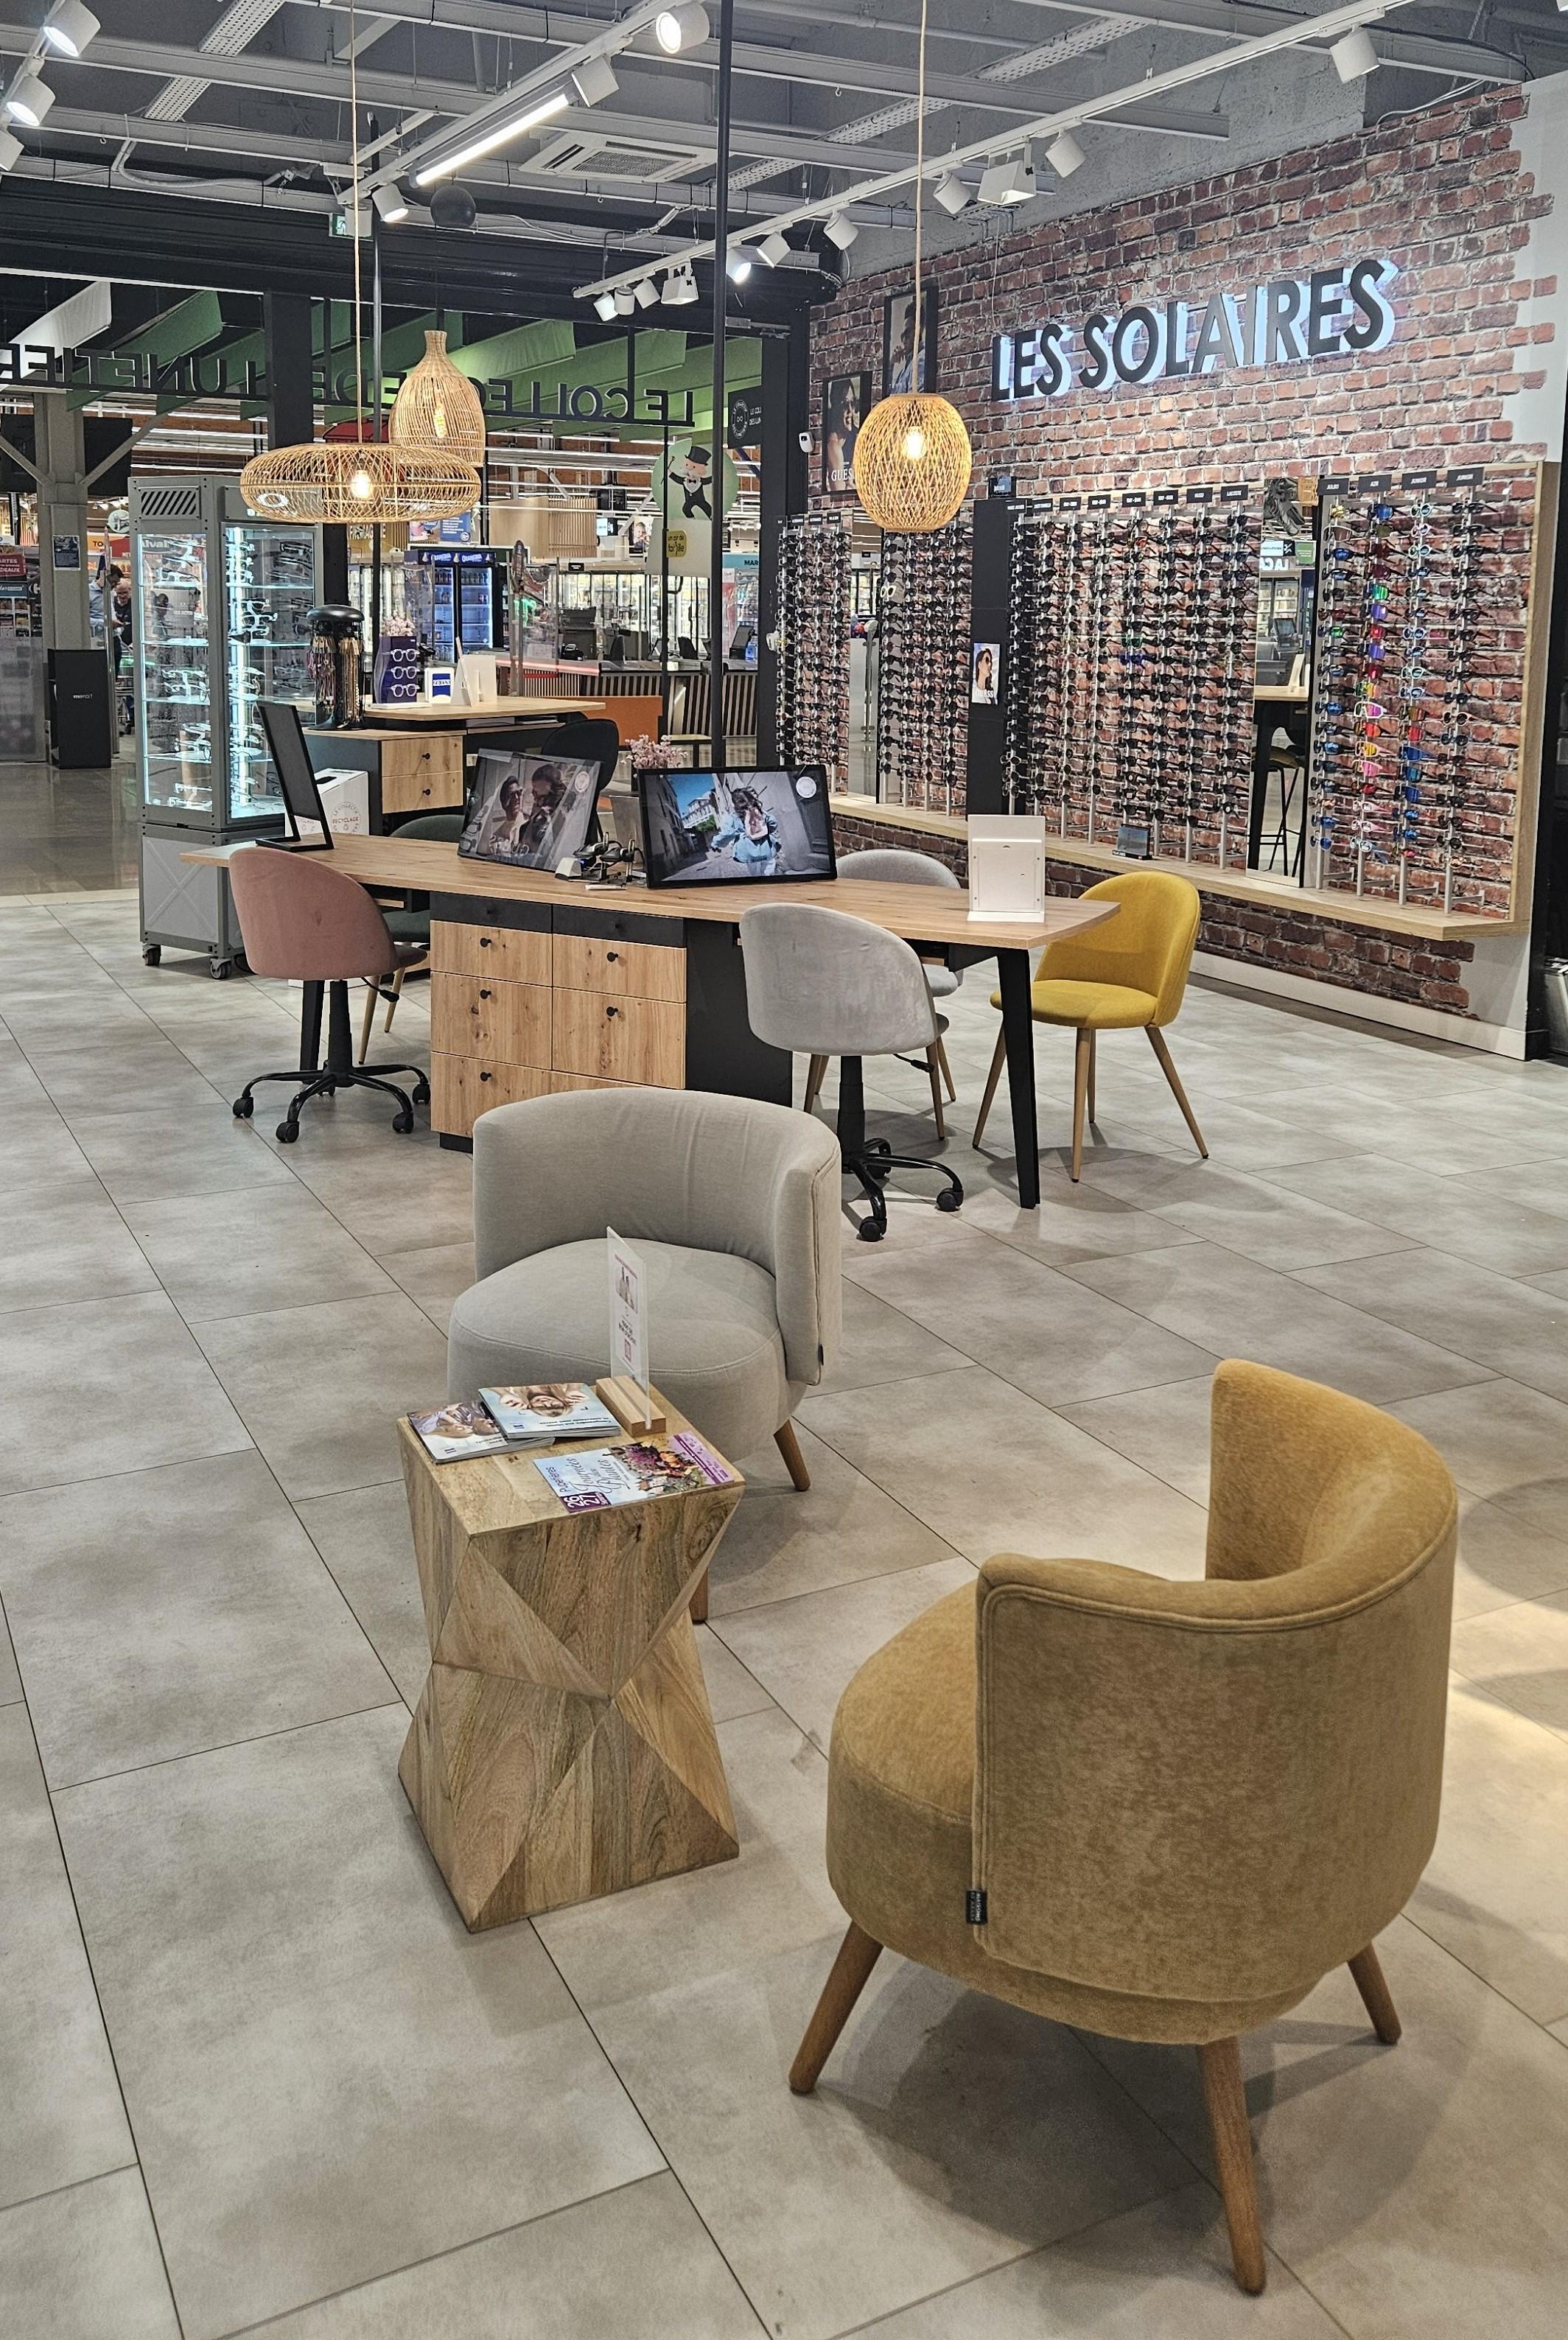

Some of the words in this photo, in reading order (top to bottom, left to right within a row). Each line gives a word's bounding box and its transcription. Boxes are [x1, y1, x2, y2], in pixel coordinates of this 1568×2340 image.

[991, 323, 1063, 402] LES
[1078, 259, 1385, 389] SOLAIRES
[830, 469, 853, 482] GUES
[597, 1460, 631, 1490] Plantes
[563, 1496, 584, 1508] 26
[579, 1493, 601, 1507] 27
